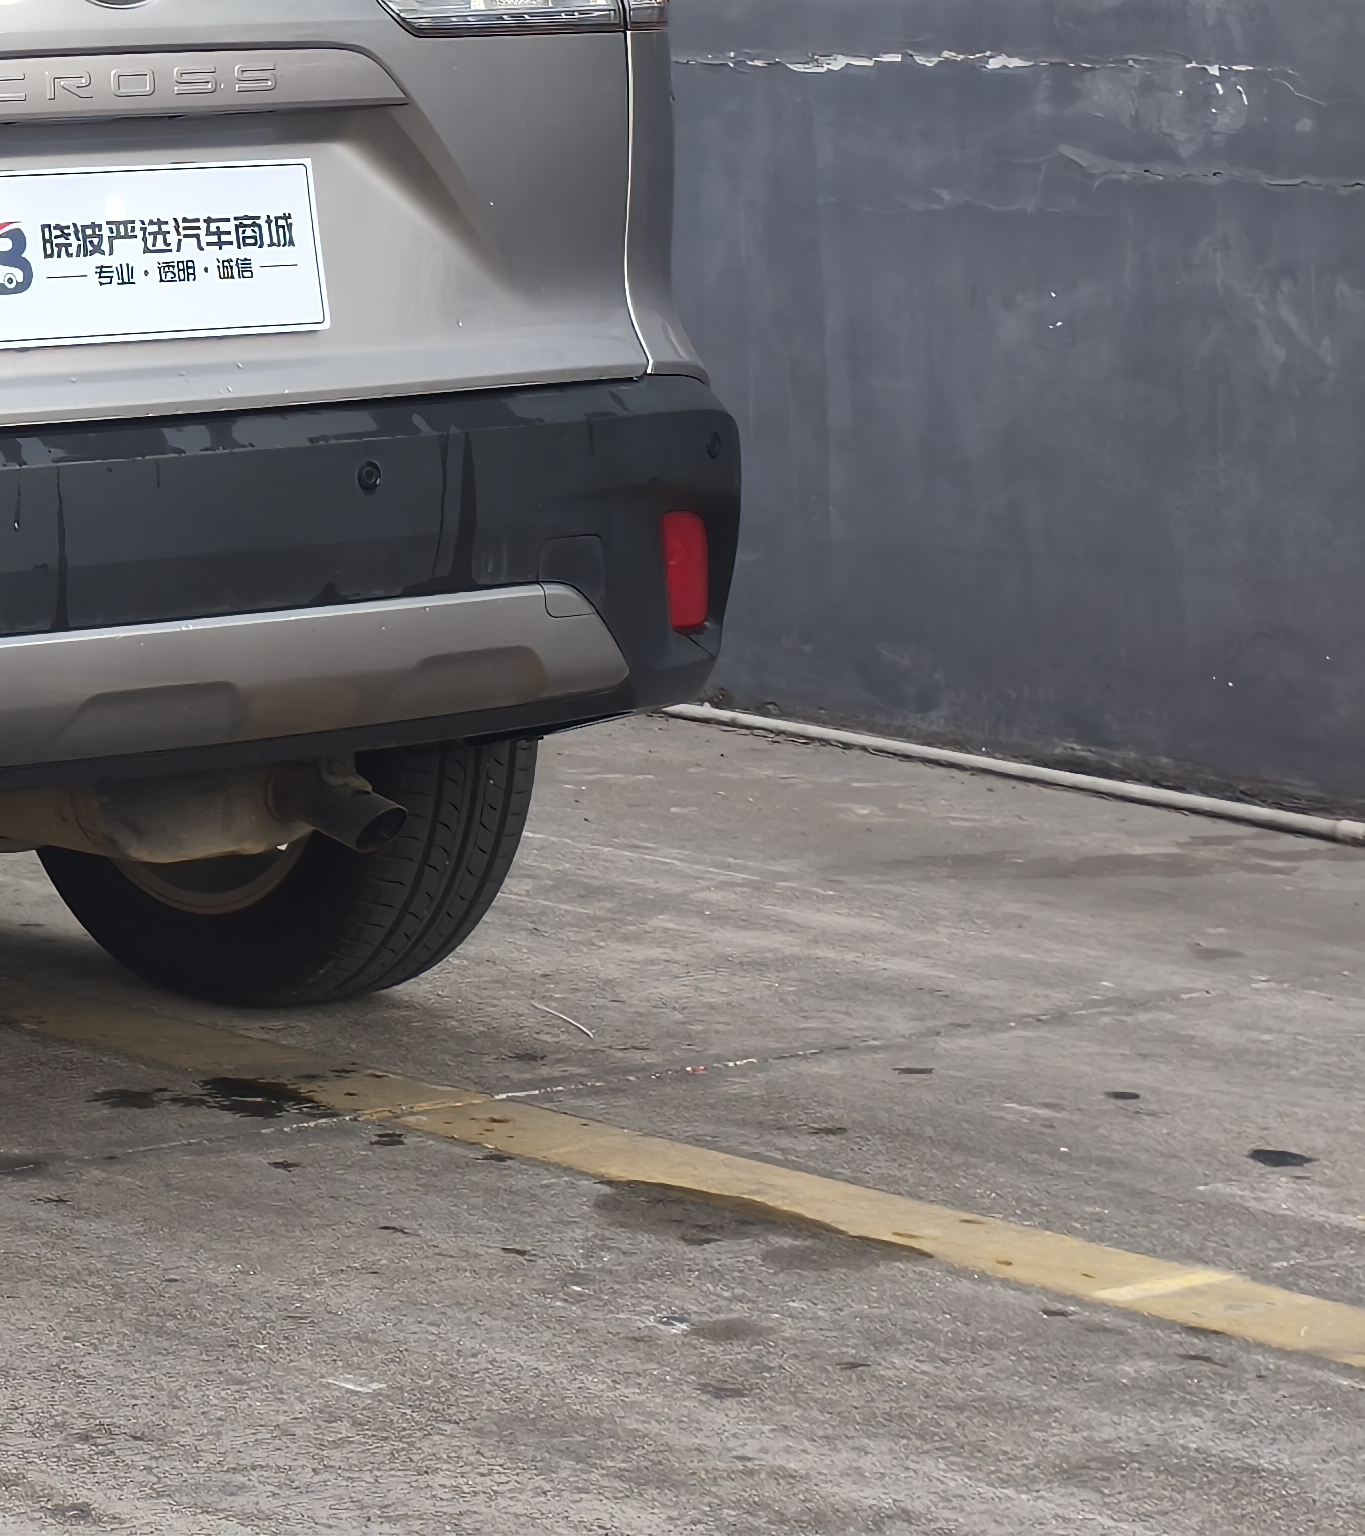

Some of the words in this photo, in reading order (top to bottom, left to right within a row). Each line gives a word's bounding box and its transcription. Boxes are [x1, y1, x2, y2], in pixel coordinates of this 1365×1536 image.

[40, 212, 297, 260] 晓波严选汽车商城
